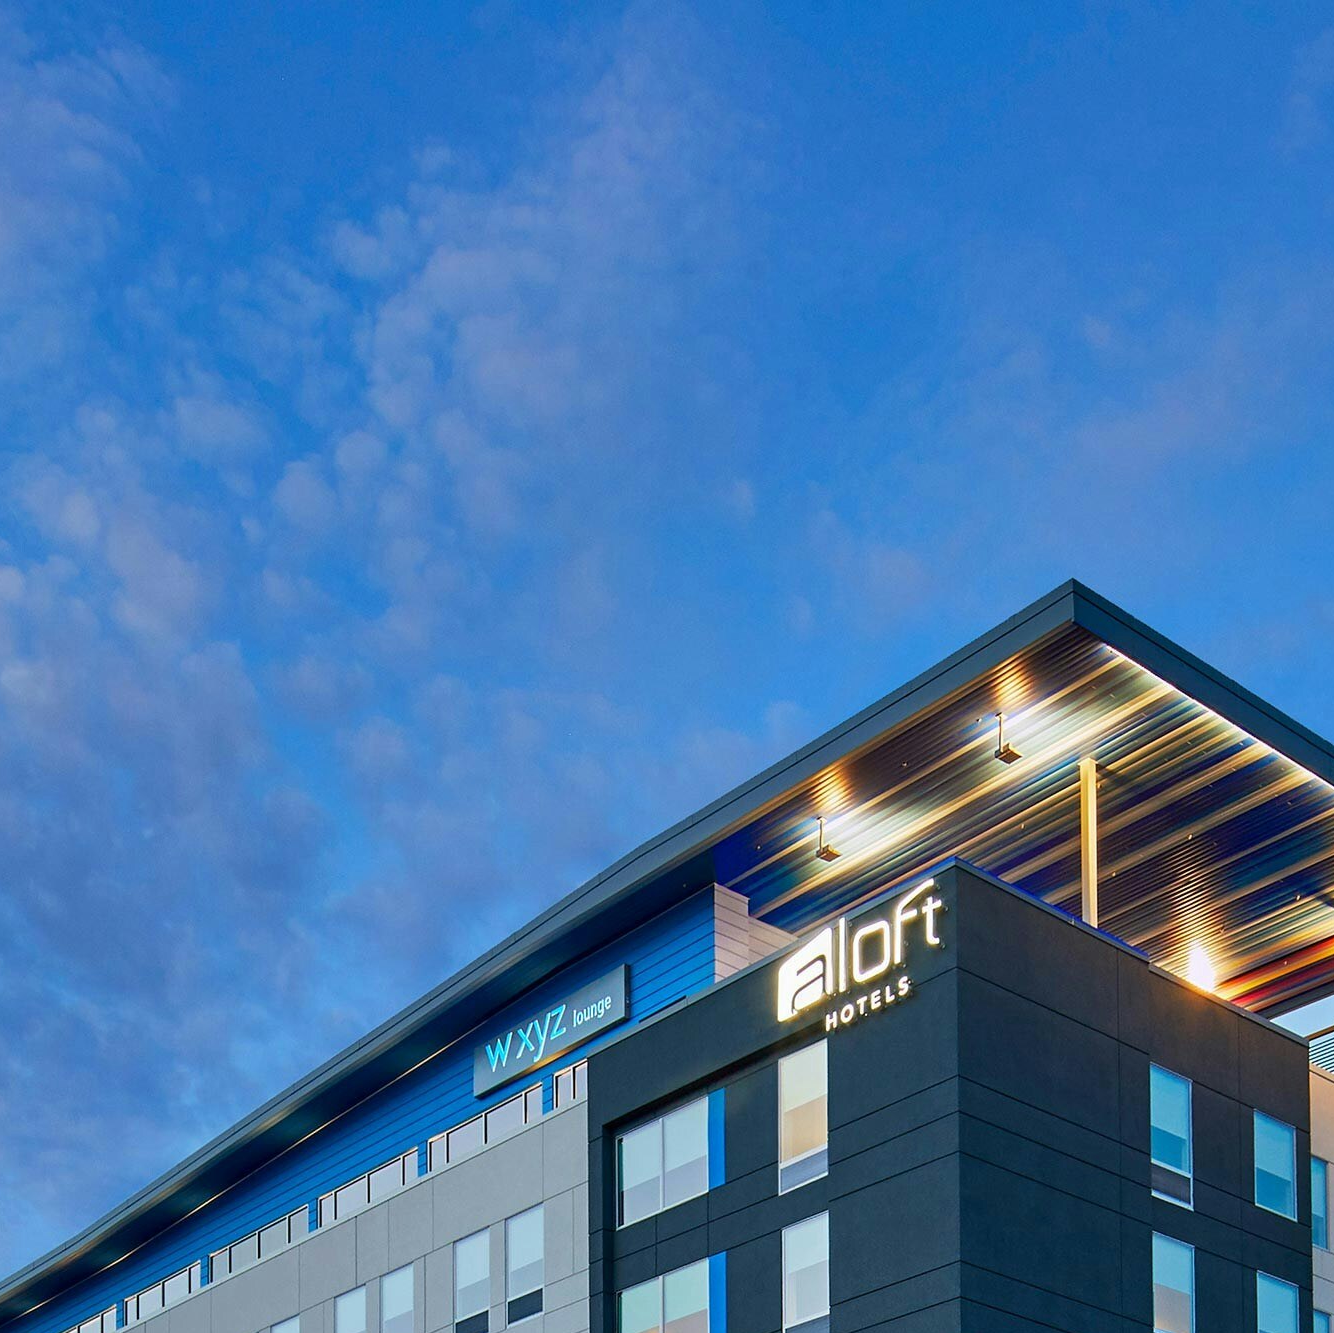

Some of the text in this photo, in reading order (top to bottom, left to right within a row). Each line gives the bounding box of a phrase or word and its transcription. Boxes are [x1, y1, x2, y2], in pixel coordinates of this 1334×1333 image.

[777, 878, 942, 1022] aloft
[573, 996, 611, 1026] lounge
[825, 975, 911, 1031] HOTELS
